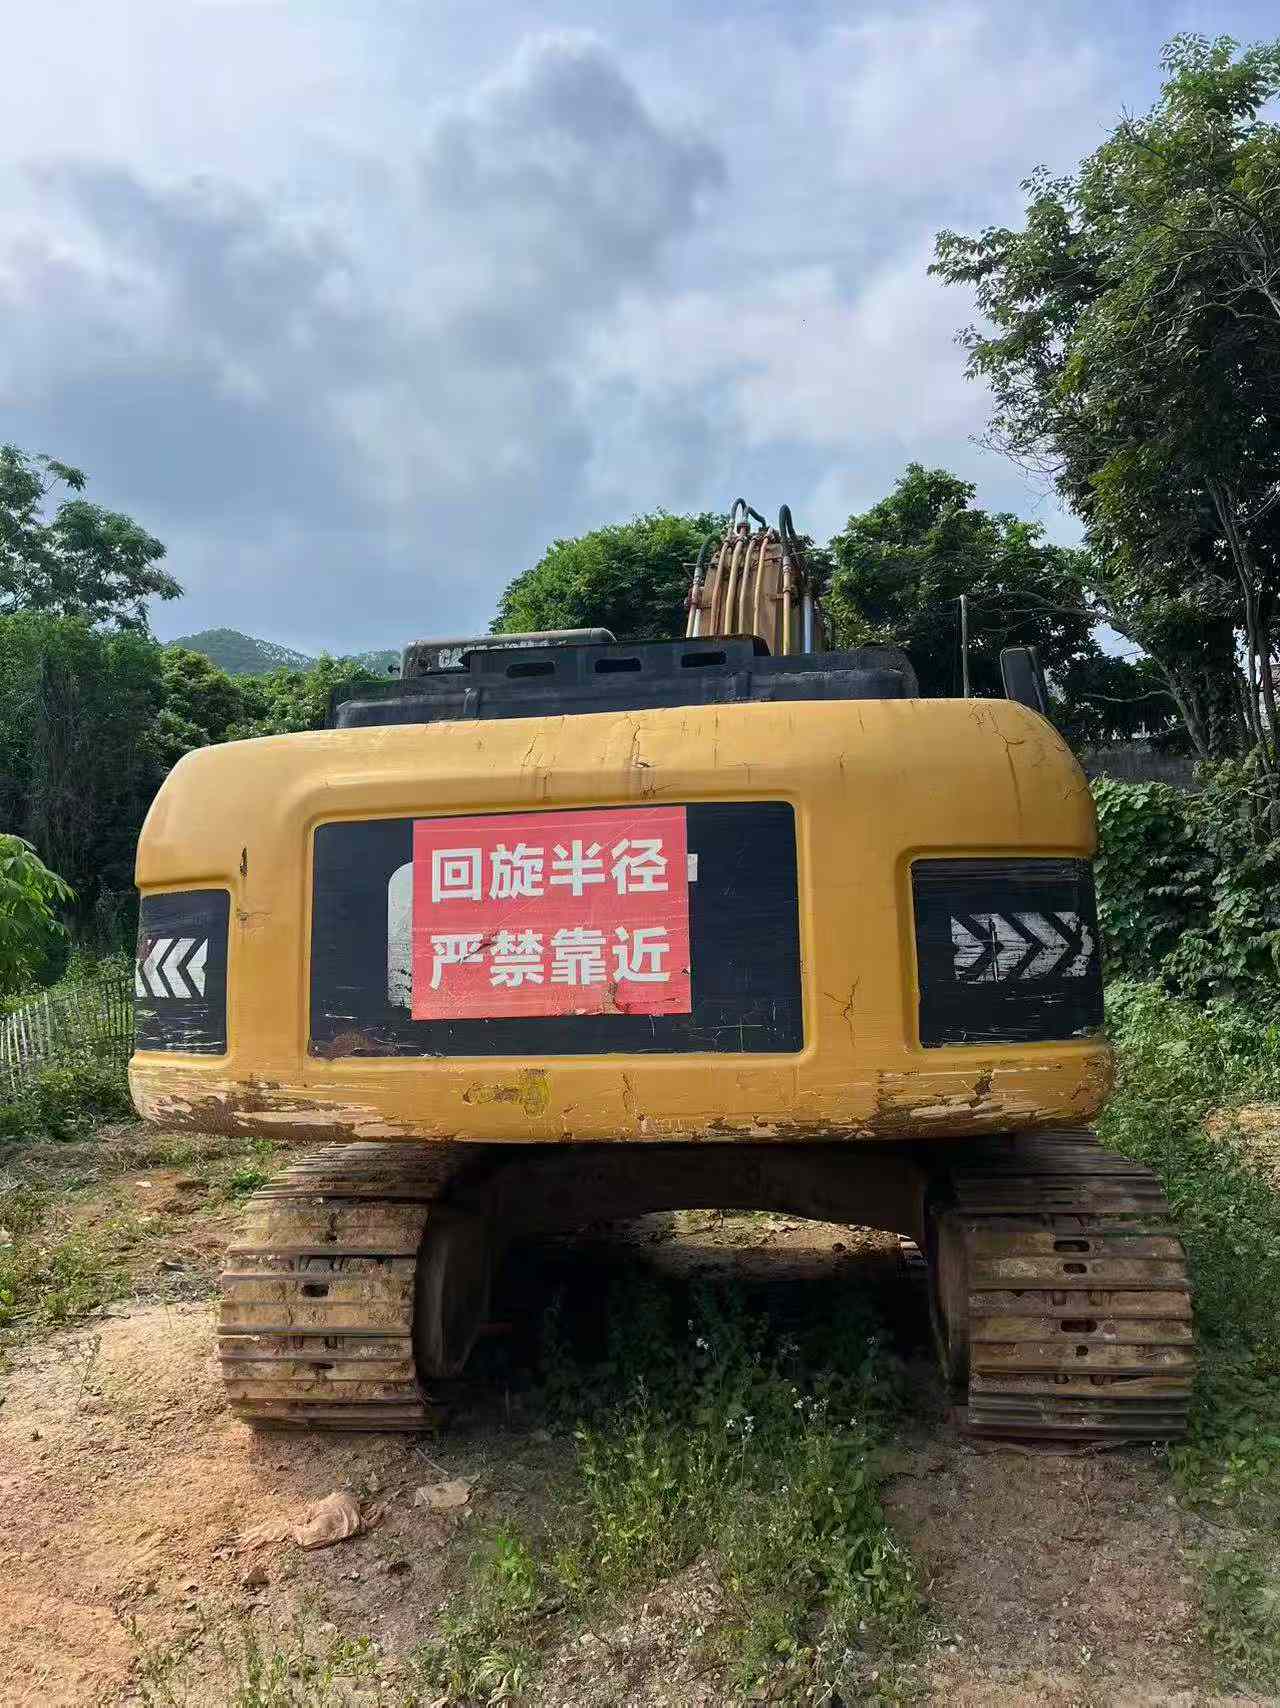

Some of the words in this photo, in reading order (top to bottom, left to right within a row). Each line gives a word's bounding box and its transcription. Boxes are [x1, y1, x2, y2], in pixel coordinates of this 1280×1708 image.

[431, 838, 669, 903] 回旋半径
[430, 926, 670, 990] 严禁靠近
